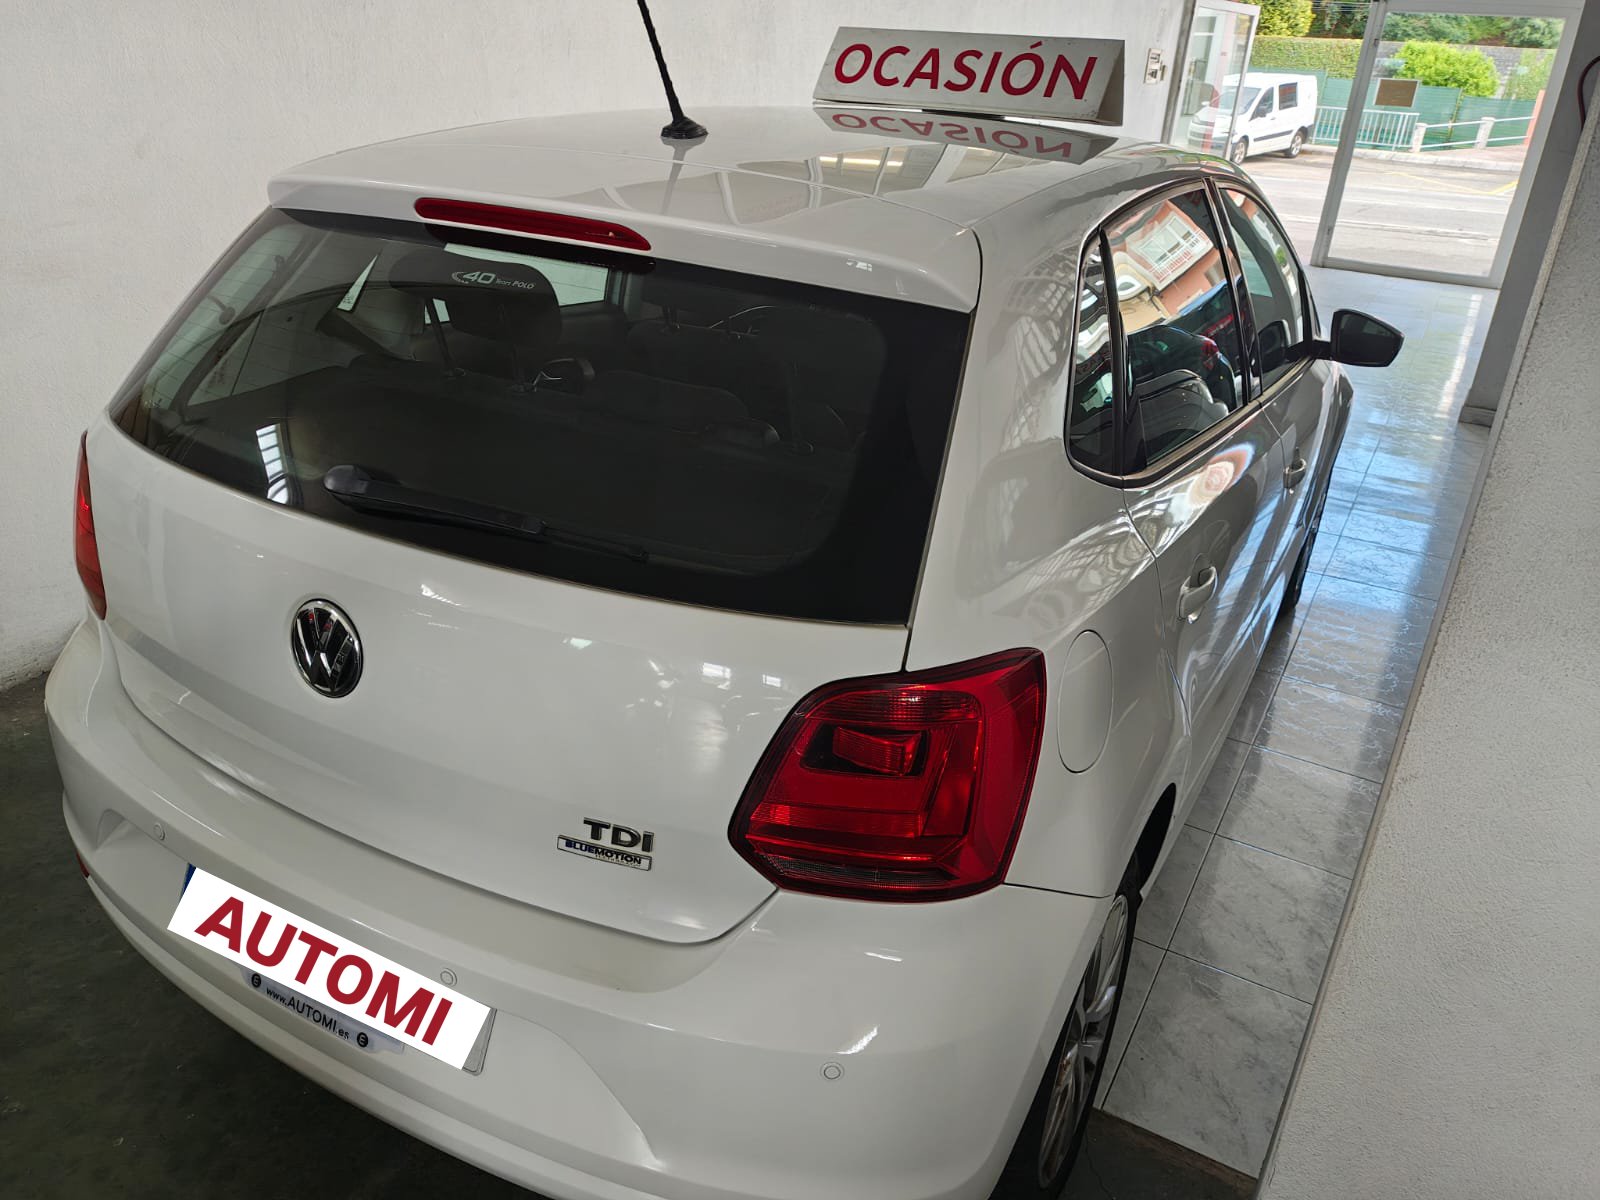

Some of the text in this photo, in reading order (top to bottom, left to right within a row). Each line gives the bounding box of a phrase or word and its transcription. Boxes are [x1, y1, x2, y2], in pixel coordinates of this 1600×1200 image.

[834, 40, 1098, 100] OCASIÓN
[462, 271, 496, 284] 40
[564, 838, 642, 865] BLUEMOTION
[583, 816, 655, 853] TDI
[266, 987, 349, 1040] www.AUTOMI.es
